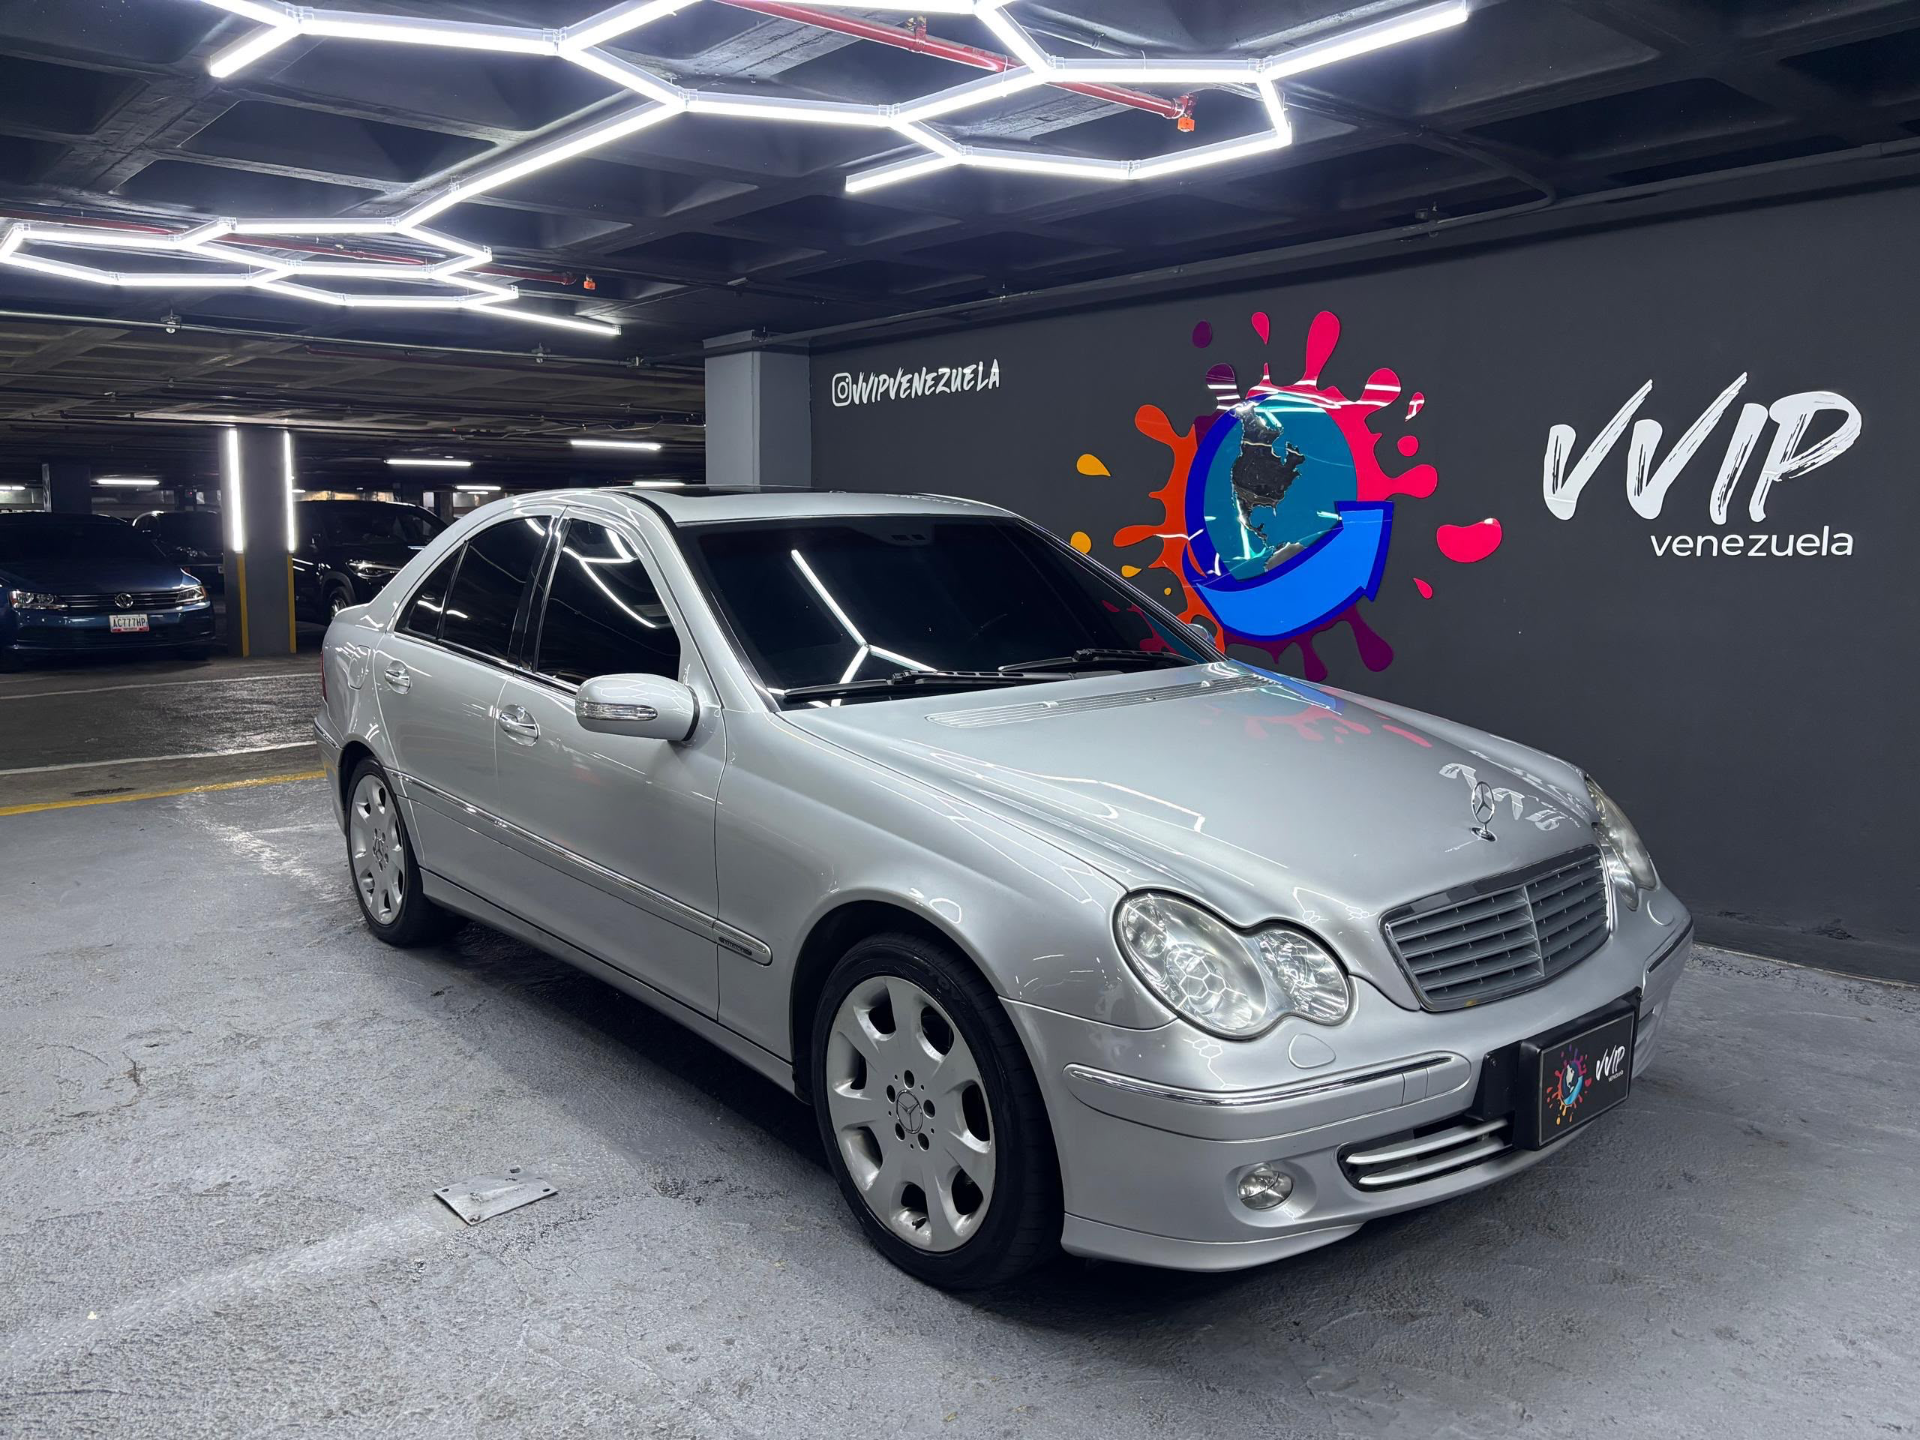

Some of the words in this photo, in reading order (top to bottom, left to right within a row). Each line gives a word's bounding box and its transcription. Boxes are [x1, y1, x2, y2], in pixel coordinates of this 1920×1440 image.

[852, 358, 1000, 405] VVIPVENEZUELA
[1542, 371, 1862, 525] VVIP
[1650, 525, 1854, 557] venezuela
[1595, 1044, 1626, 1081] VVIP
